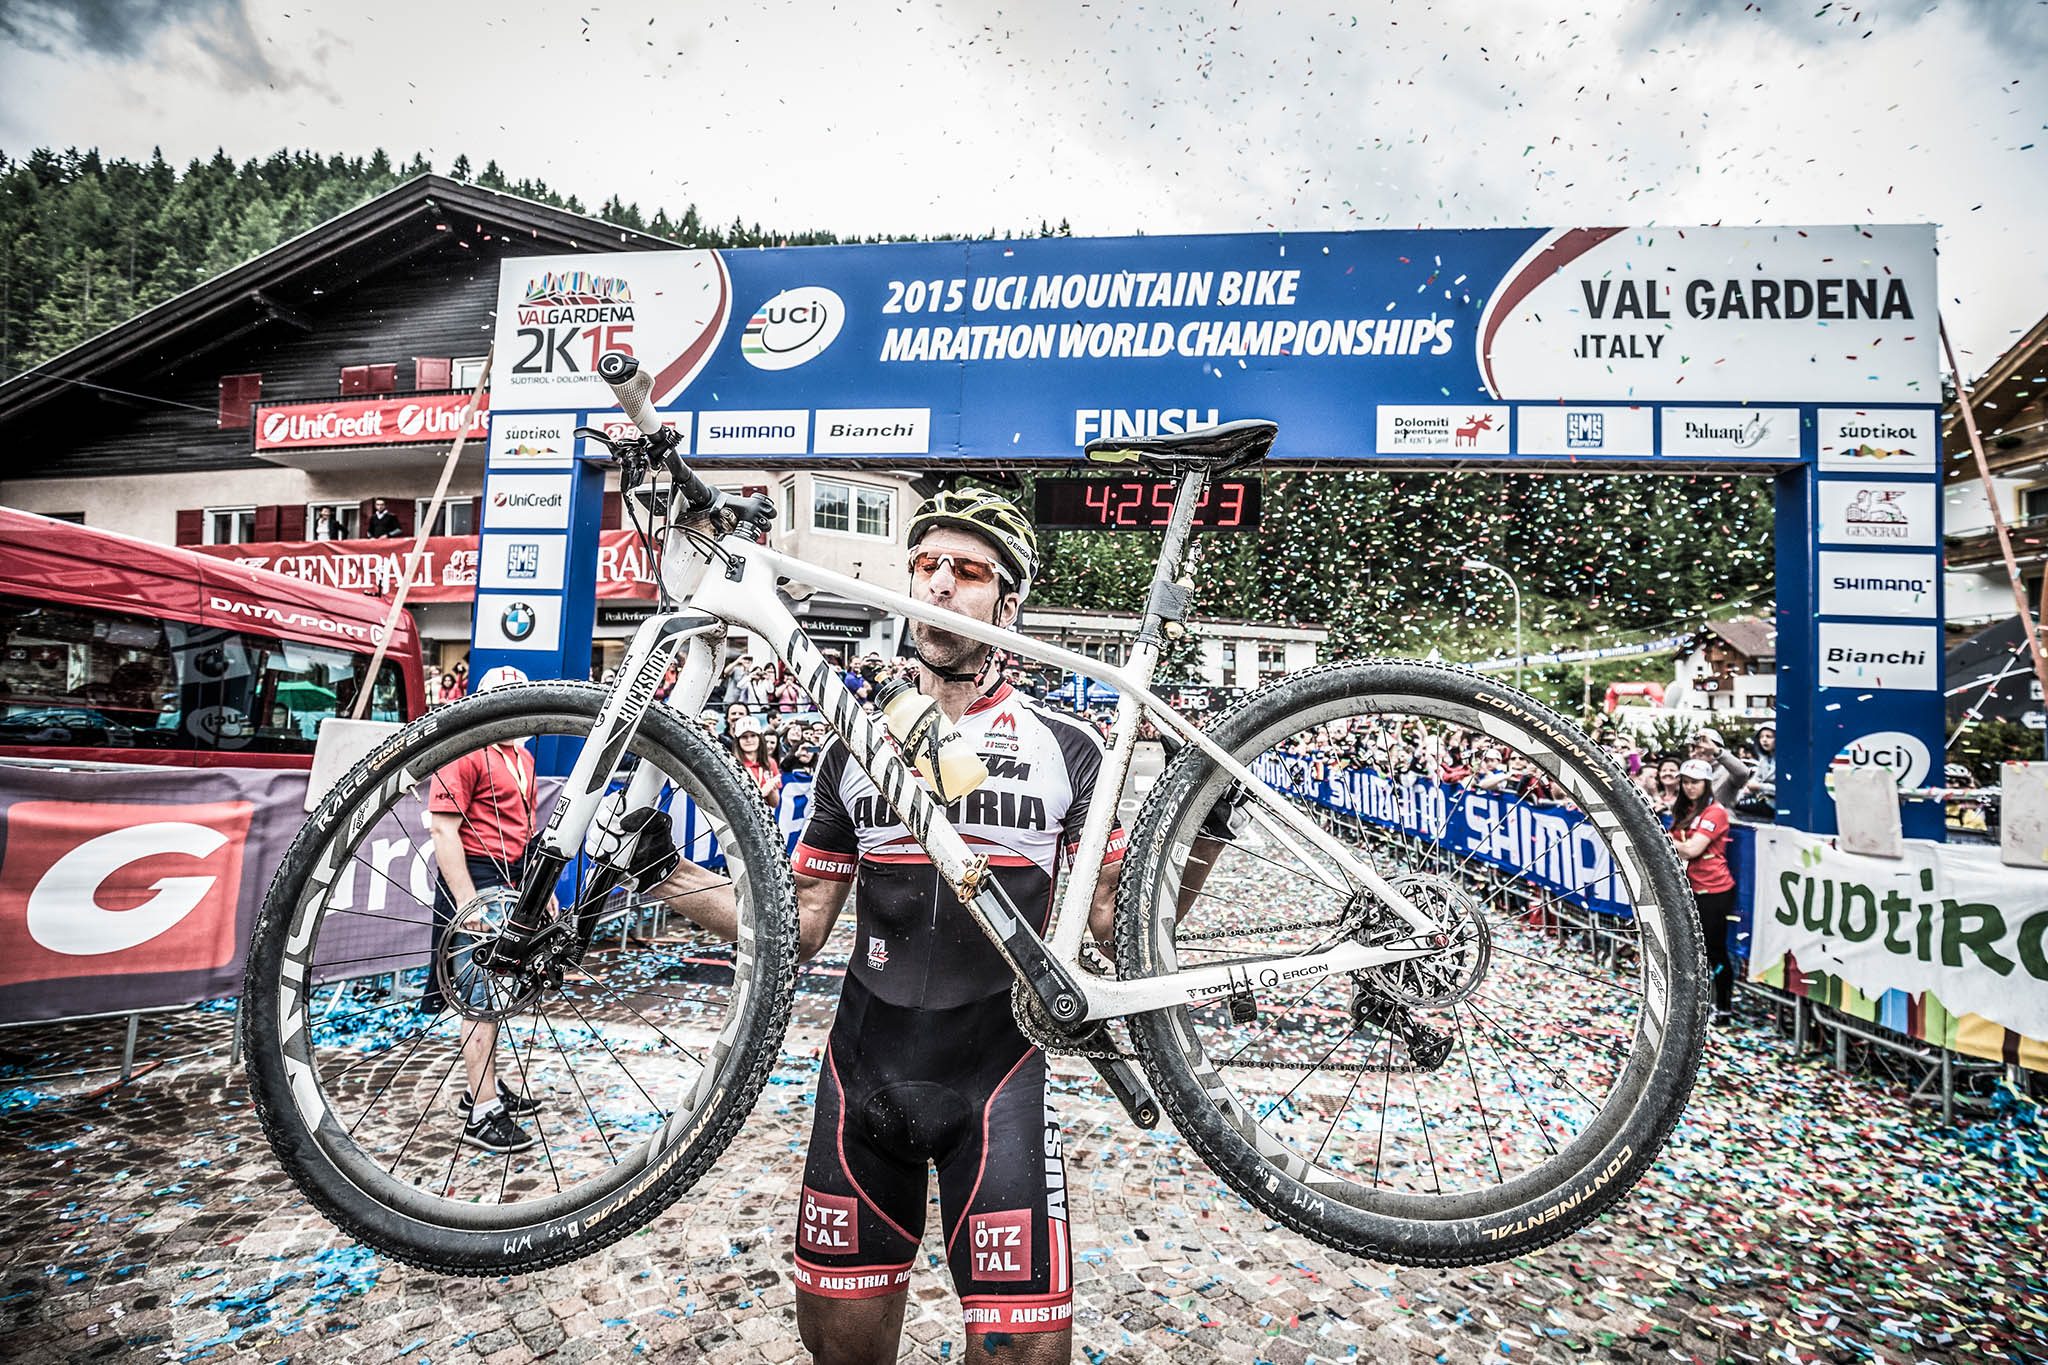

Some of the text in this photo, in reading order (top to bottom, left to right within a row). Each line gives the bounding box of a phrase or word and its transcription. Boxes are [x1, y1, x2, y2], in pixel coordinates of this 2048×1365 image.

[882, 269, 1300, 314] 2015 UCI MOUNTAIN BIKE
[1581, 278, 1914, 321] VAL GARDENA
[880, 318, 1454, 363] MARATHON WORLD CHAMPIONSHIPS
[1579, 334, 1665, 359] ITALY
[290, 411, 382, 440] UniCredit
[709, 425, 795, 439] SHIMANO
[829, 423, 914, 438] Bianchi
[1074, 408, 1219, 446] FINISH
[1394, 417, 1449, 427] Dolomiti
[1568, 414, 1603, 440] SMS
[1685, 421, 1744, 443] Paluani
[508, 493, 562, 507] UniCredit
[1847, 527, 1910, 538] GENERALI
[508, 546, 538, 571] SMS
[1833, 576, 1923, 593] SHIMANO
[210, 597, 367, 638] DATASPORT
[1827, 647, 1926, 666] Bianchi
[603, 654, 634, 711] ERGON
[905, 710, 940, 753] TOPEAK
[1474, 691, 1614, 791] CONTINENTAL
[1464, 793, 1635, 904] SHIMA
[1282, 963, 1329, 980] ERGON
[1482, 1145, 1633, 1241] CONTINENTAL
[805, 1195, 848, 1226] ÖTZ
[804, 1224, 848, 1246] TAL
[975, 1221, 1021, 1248] ÖTZ
[976, 1249, 1020, 1271] TAL
[819, 1275, 888, 1290] AUSTRIA
